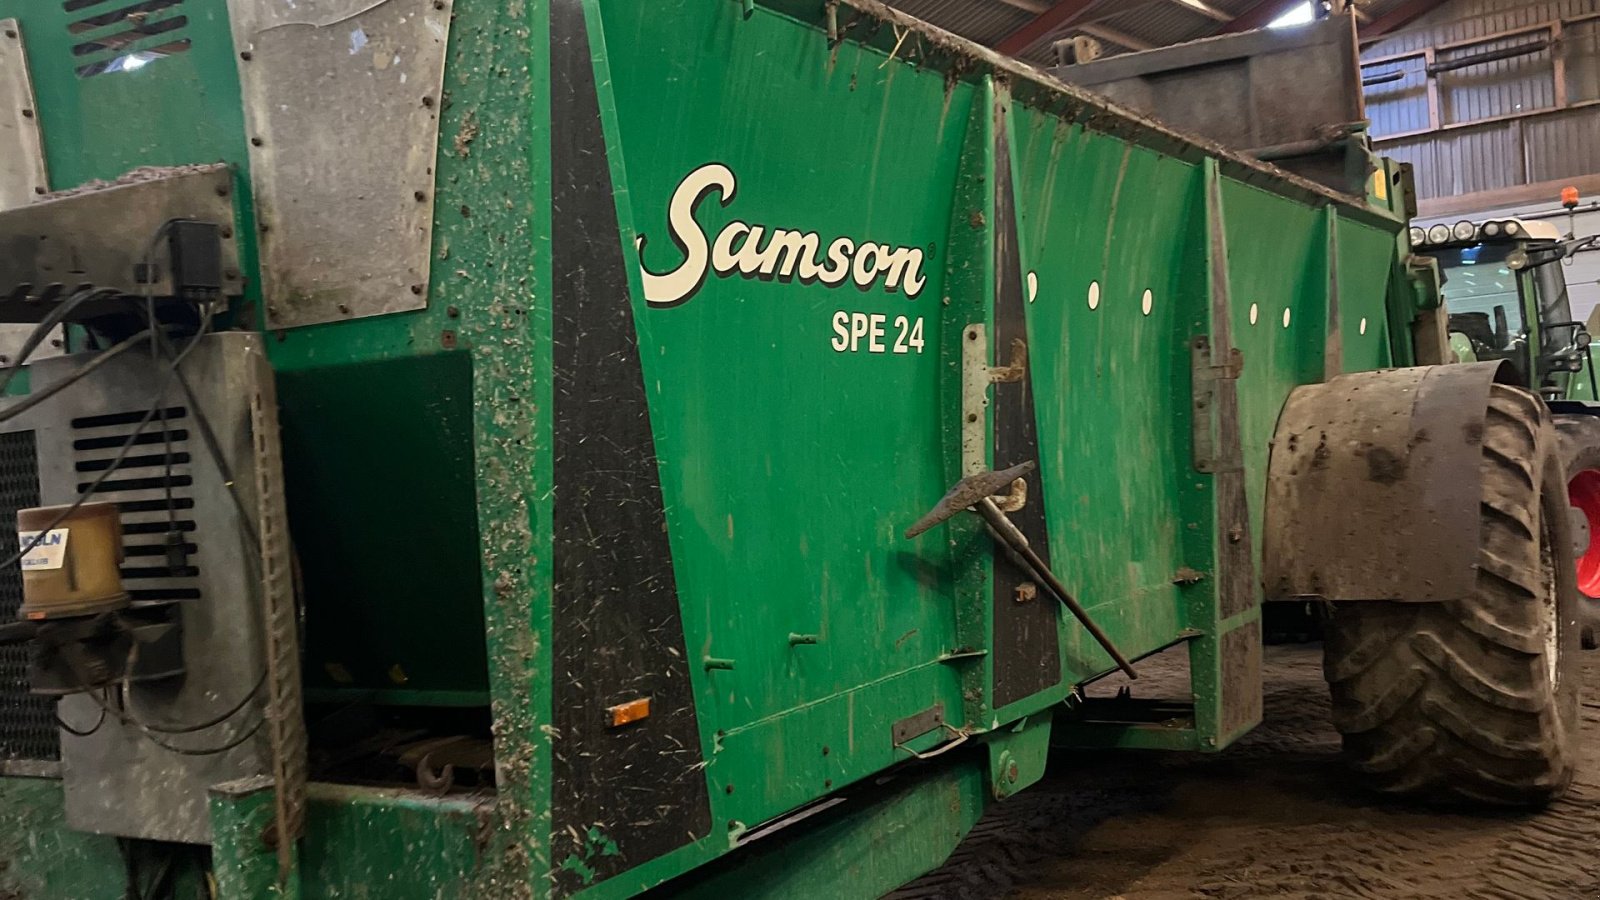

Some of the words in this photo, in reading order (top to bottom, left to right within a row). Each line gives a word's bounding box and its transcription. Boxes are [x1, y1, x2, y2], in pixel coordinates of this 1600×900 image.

[636, 162, 927, 309] Samson
[831, 310, 886, 353] SPE
[892, 315, 925, 354] 24
